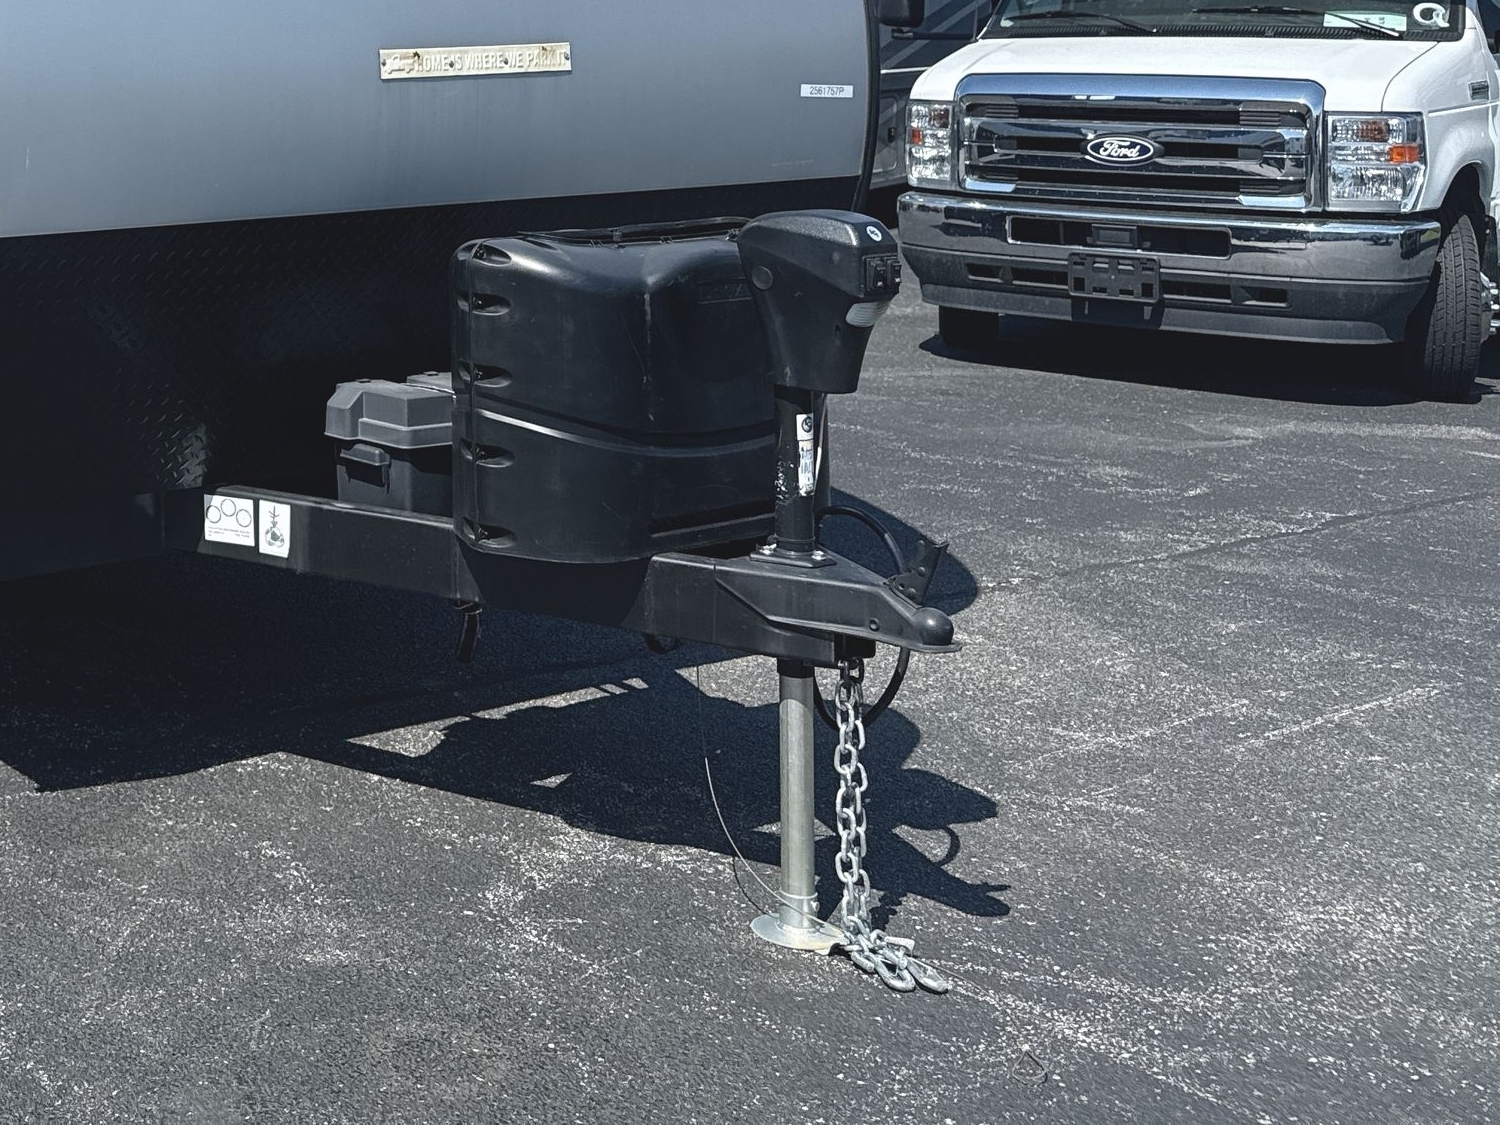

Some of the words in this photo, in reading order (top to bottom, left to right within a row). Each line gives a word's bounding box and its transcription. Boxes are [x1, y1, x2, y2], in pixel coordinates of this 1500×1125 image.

[414, 53, 450, 73] HOME
[464, 52, 505, 72] WHERE
[505, 51, 524, 69] WE
[526, 49, 554, 68] PARK
[1099, 140, 1141, 158] Ford
